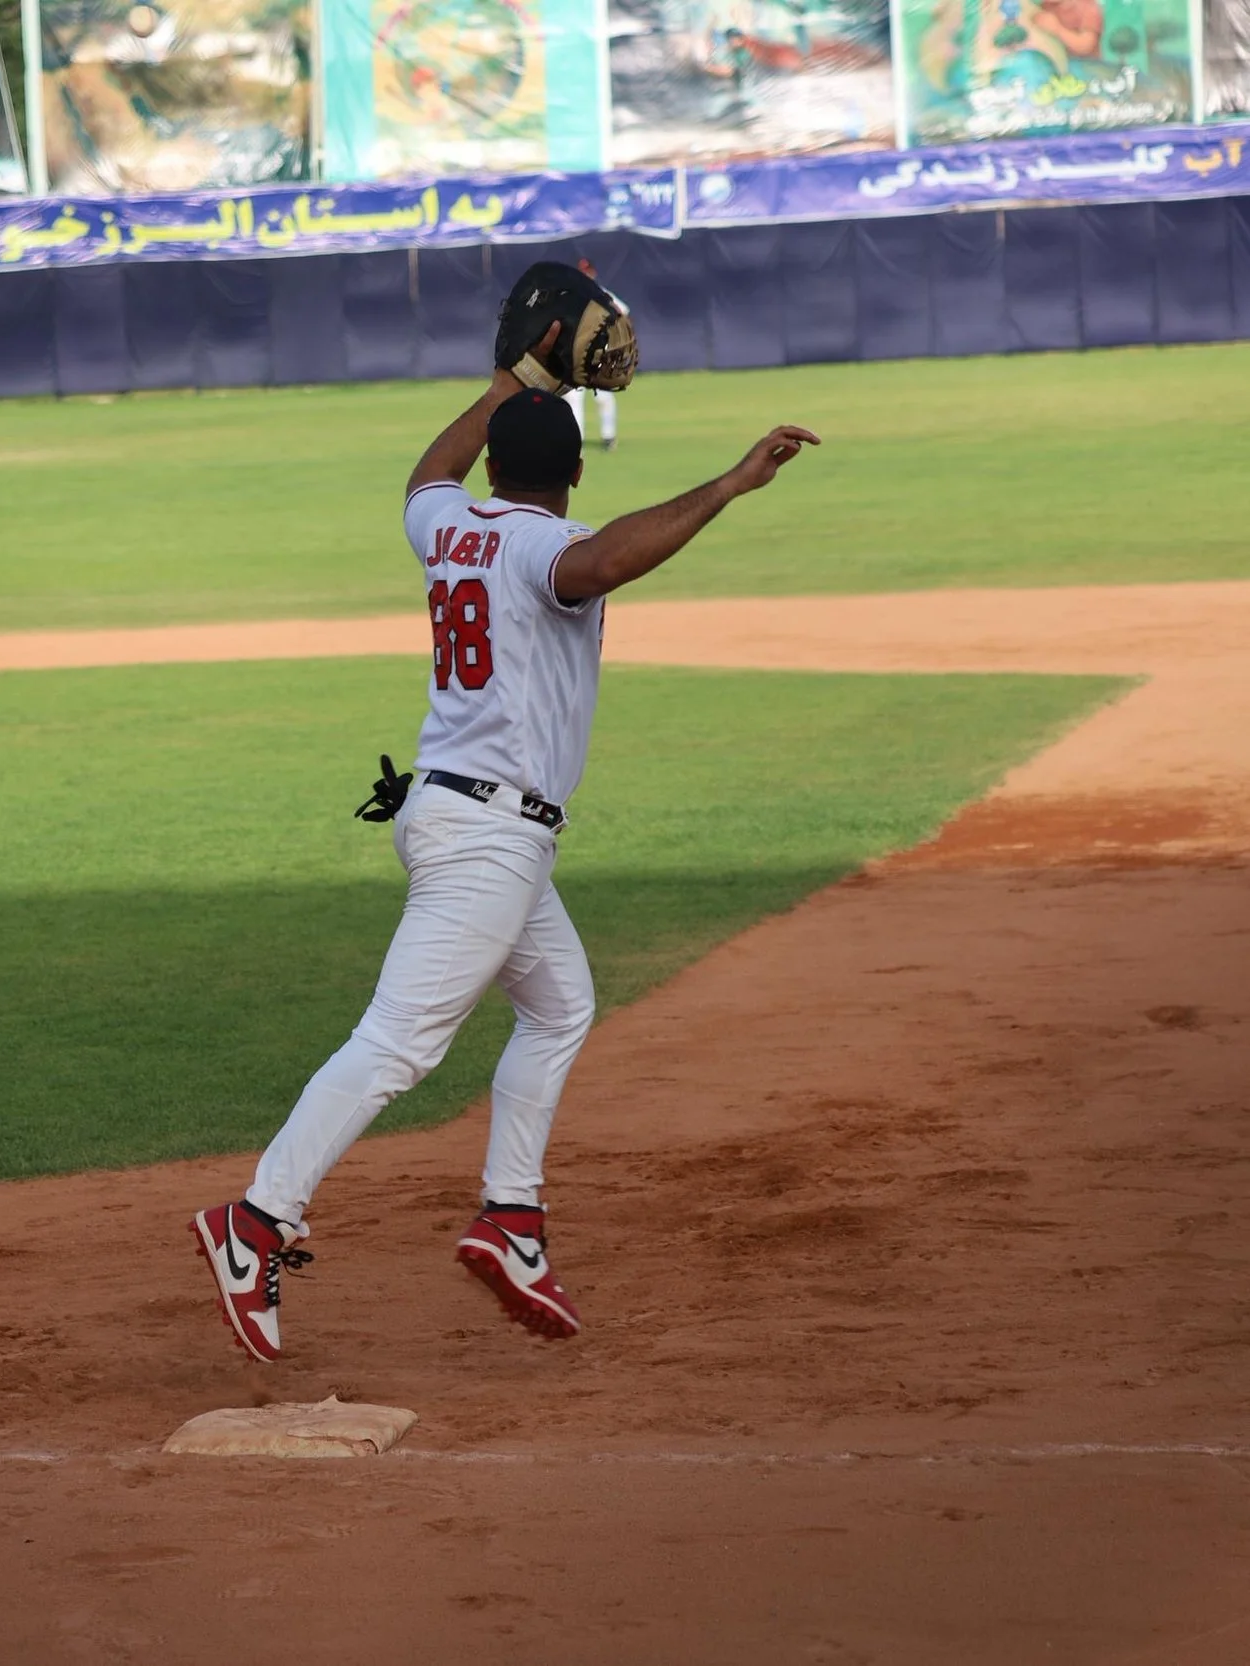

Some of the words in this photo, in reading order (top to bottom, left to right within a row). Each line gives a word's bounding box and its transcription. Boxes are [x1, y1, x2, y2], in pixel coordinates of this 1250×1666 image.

[859, 154, 1022, 198] زندگی
[1026, 143, 1174, 182] کلید
[1184, 139, 1244, 177] آب
[95, 199, 254, 255] البرز
[257, 187, 440, 248] استان
[450, 195, 504, 233] به
[426, 526, 500, 569] JABER
[428, 578, 494, 691] 88
